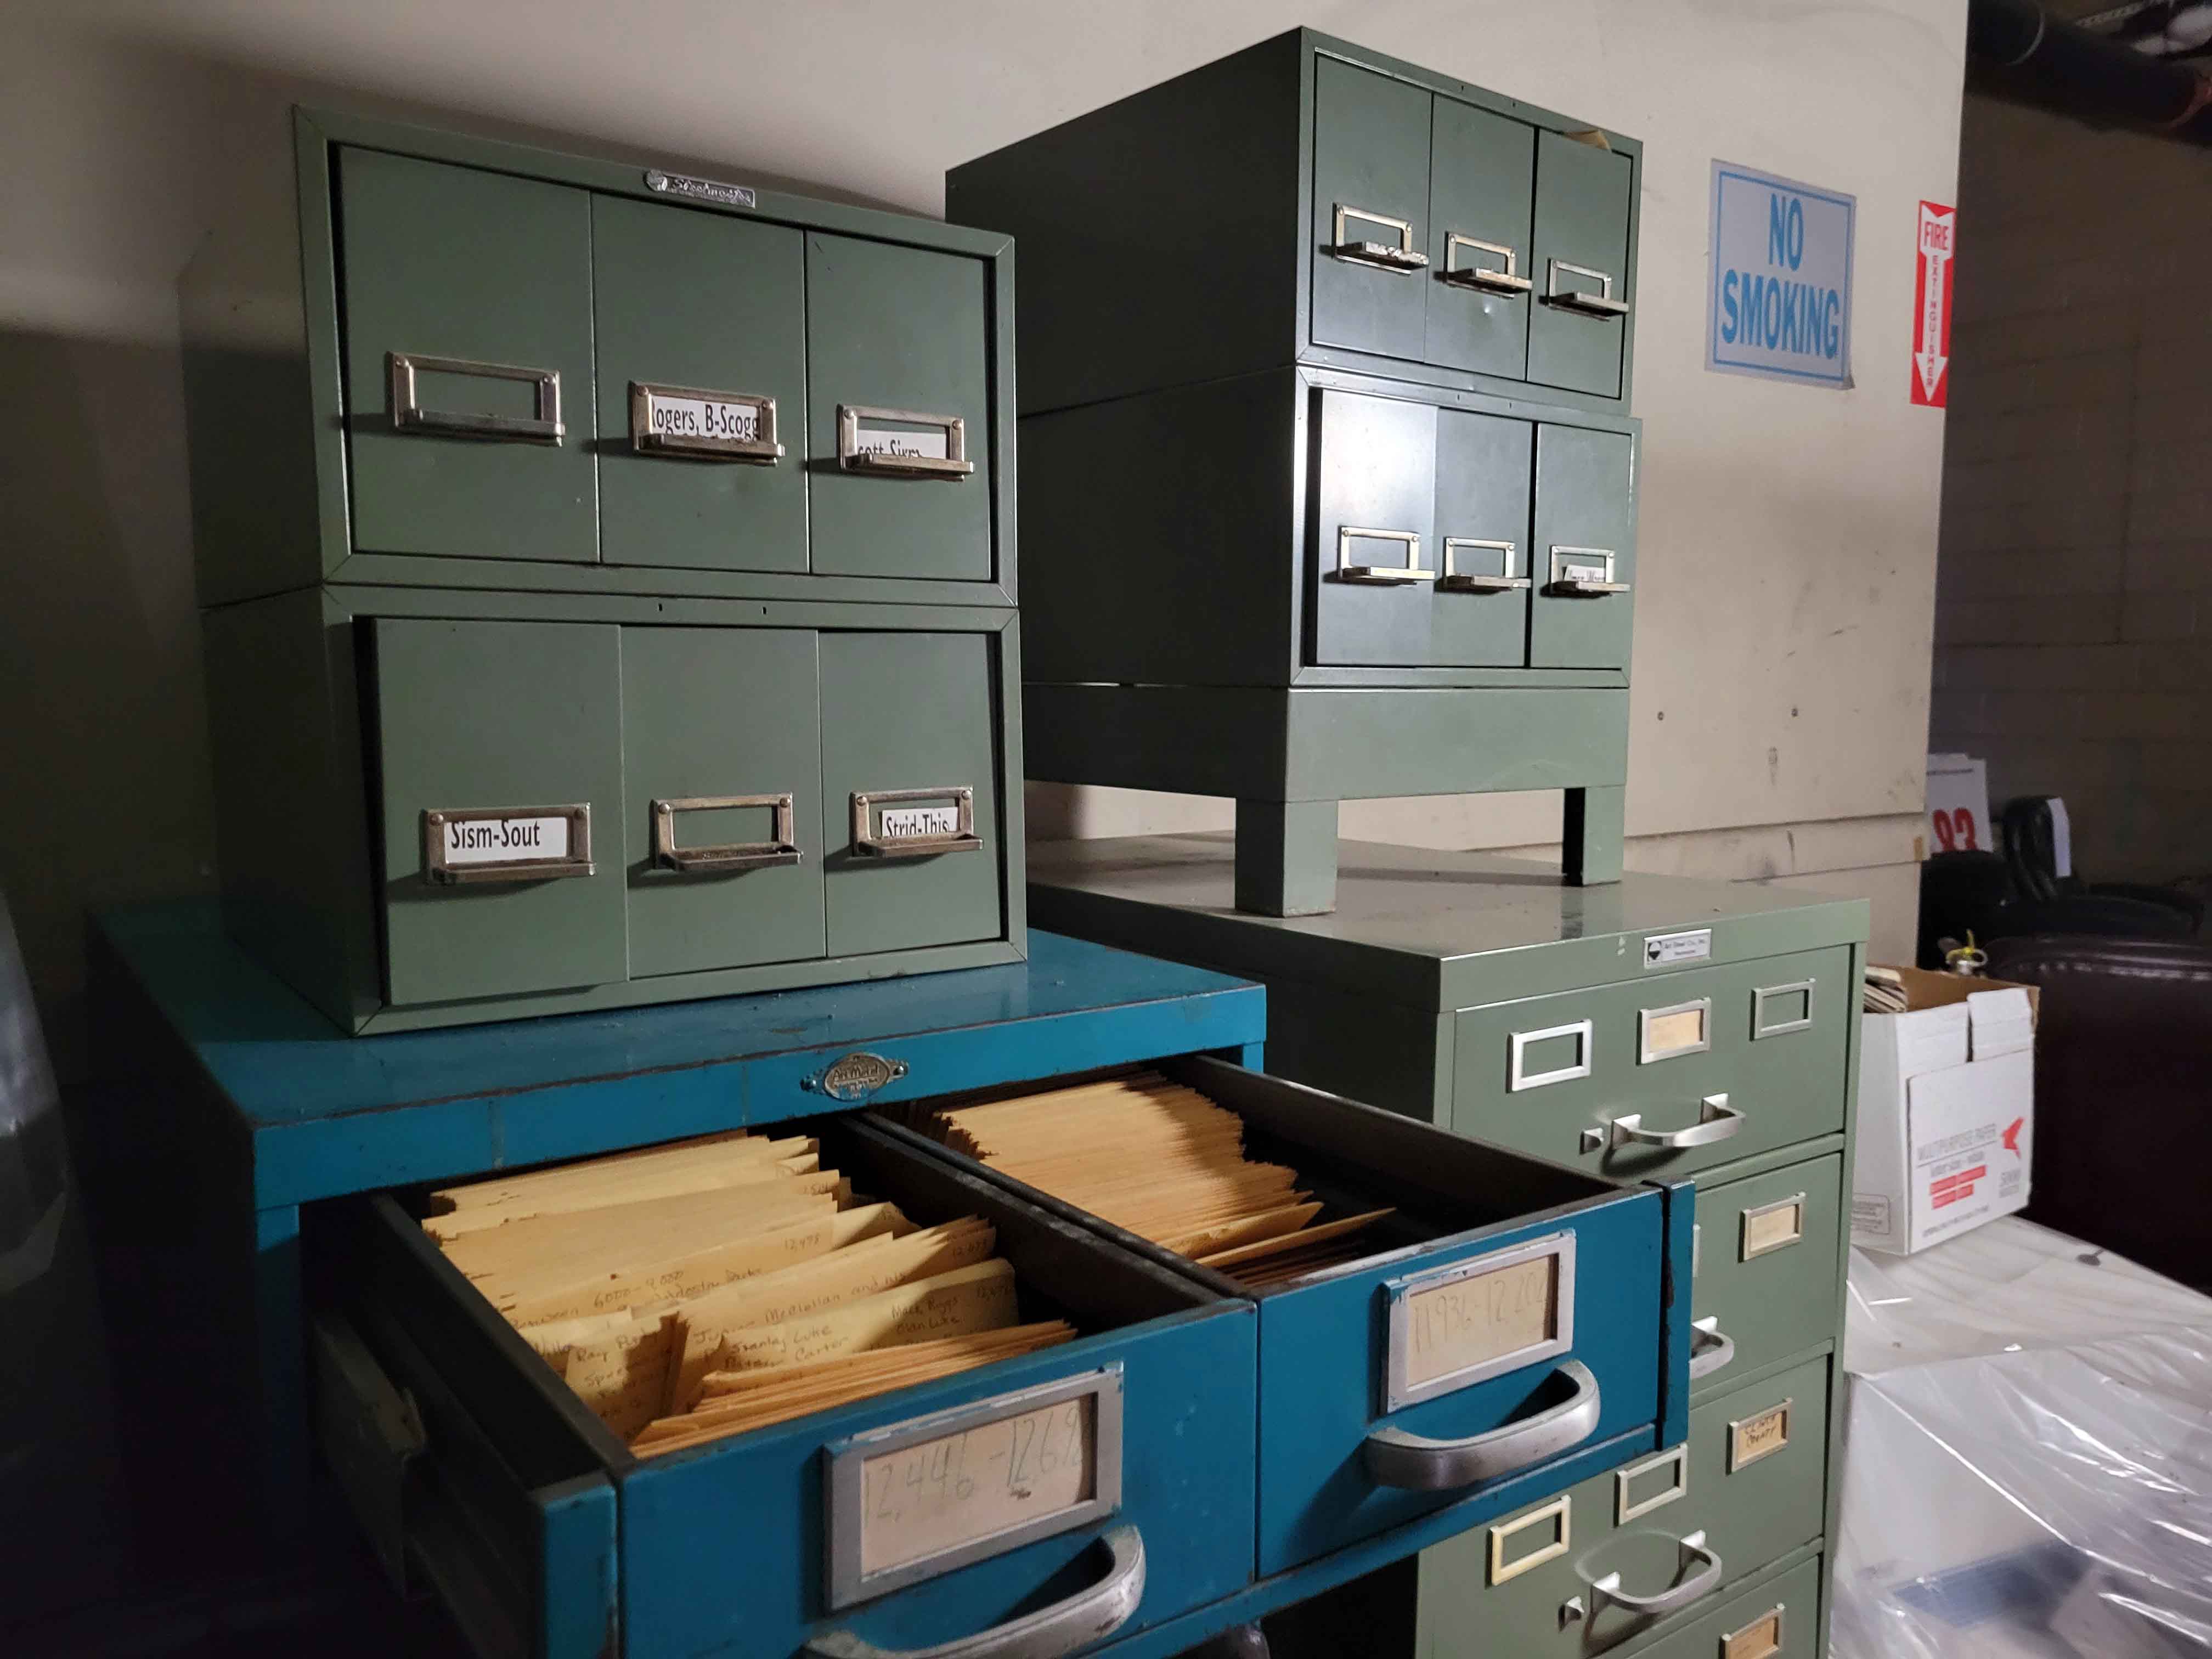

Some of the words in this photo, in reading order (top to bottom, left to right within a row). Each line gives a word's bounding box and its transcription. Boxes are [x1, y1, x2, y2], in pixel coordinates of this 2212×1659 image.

[1769, 193, 1804, 271] NO
[1924, 221, 1949, 251] FIRE
[1721, 269, 1839, 360] SMOKING
[1926, 255, 1939, 386] EXTINGUISHER
[451, 820, 540, 849] Sism-Sout
